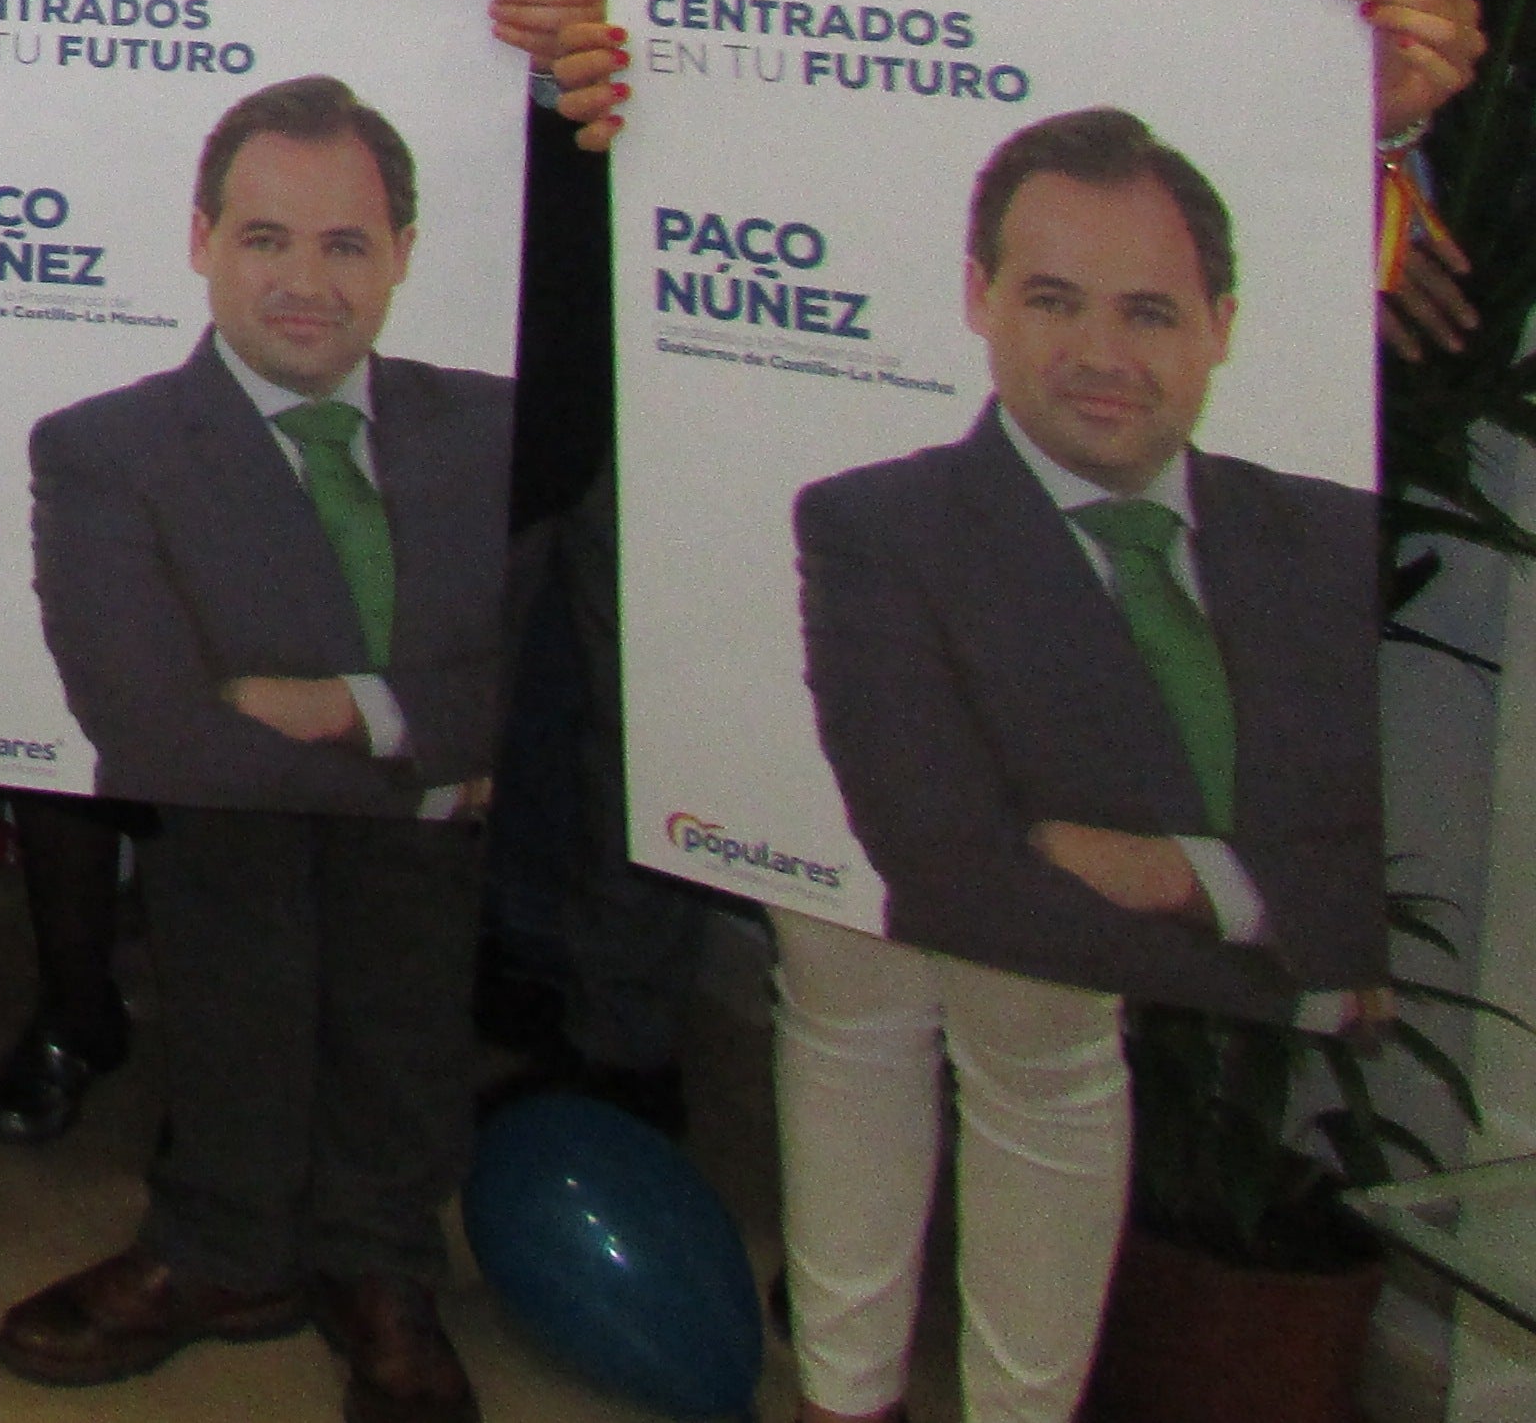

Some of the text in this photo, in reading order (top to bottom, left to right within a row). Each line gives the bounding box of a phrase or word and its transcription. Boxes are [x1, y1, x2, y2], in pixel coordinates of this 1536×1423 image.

[58, 35, 254, 74] FUTURO
[649, 38, 1031, 102] EN TU FUTURO
[655, 206, 827, 269] PACO
[111, 311, 179, 329] Mancha
[653, 262, 870, 339] NÚÑEZ
[683, 827, 842, 888] populares
